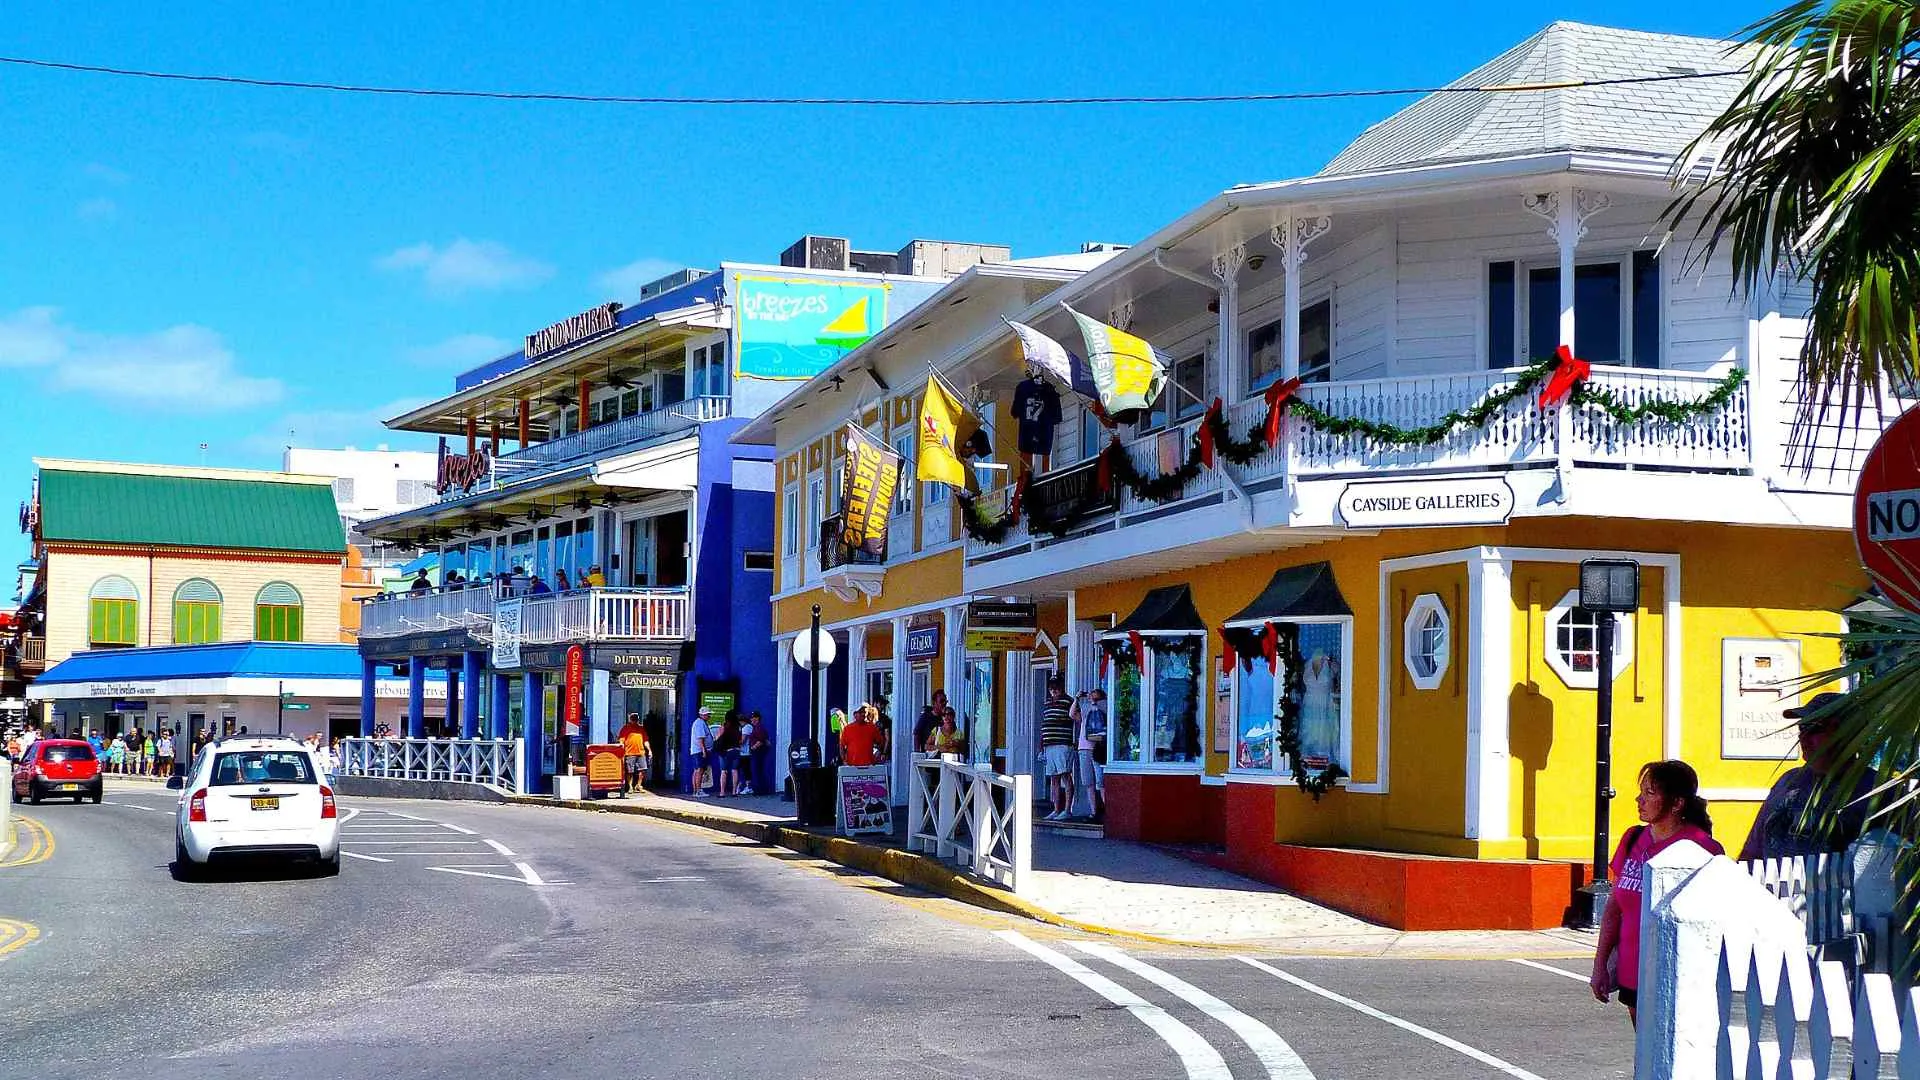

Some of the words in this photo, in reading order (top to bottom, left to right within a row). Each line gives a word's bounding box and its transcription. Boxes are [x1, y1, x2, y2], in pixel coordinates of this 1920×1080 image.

[743, 289, 828, 317] breezes
[525, 304, 612, 360] LANDMARK
[1352, 497, 1412, 513] CAYSIDE
[1415, 493, 1500, 510] GALLERIES
[1868, 498, 1920, 535] NO
[571, 651, 580, 682] CUBAN
[614, 655, 643, 665] DUTY
[645, 656, 673, 666] FREE
[625, 677, 675, 688] LANDMARK
[569, 686, 579, 720] CIGARS
